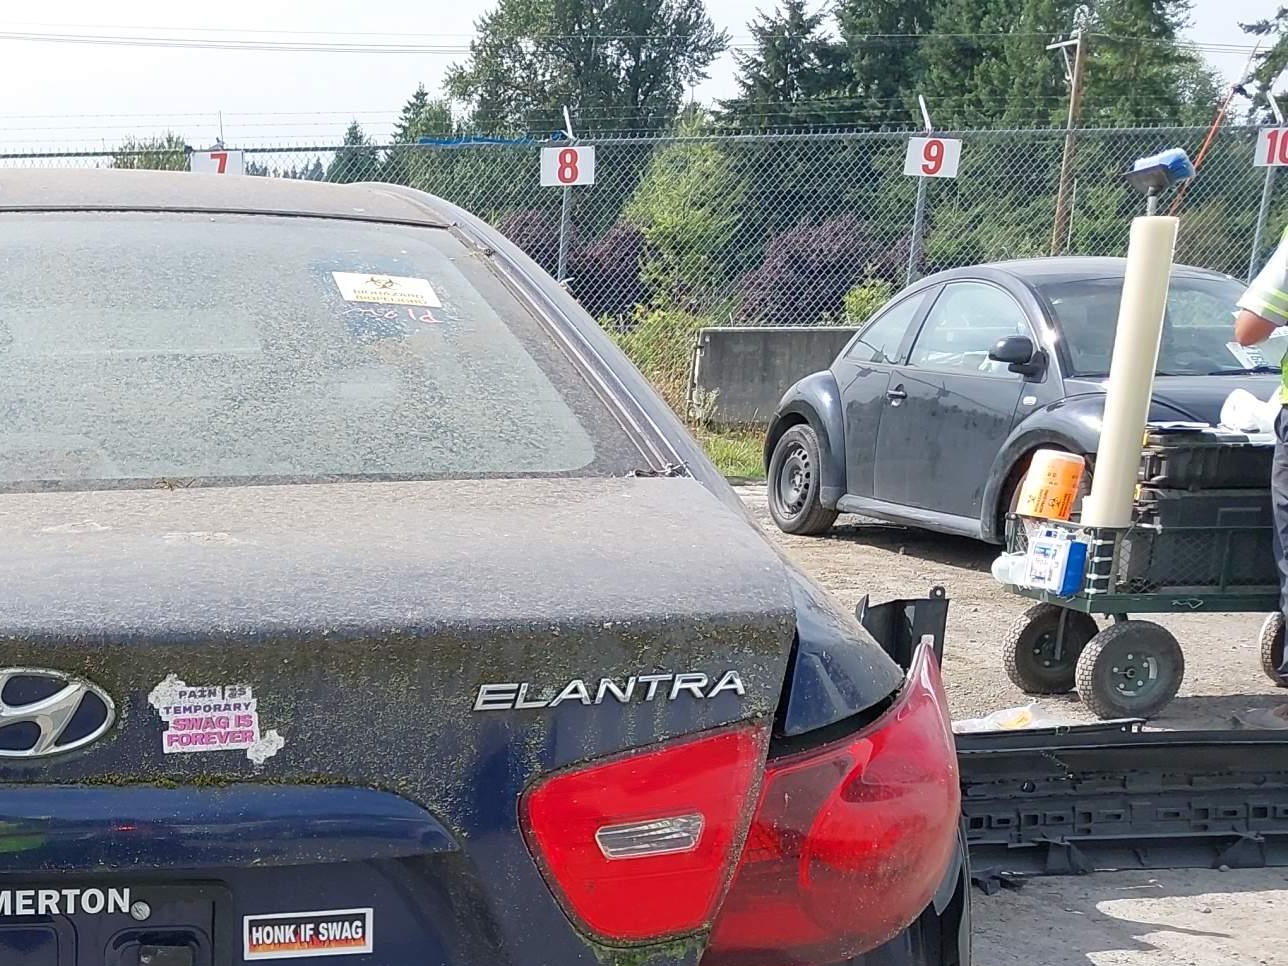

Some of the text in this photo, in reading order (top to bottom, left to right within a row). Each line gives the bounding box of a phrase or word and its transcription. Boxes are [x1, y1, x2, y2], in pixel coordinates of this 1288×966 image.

[209, 151, 228, 174] 7
[557, 148, 579, 185] 8
[921, 139, 945, 176] 9
[178, 687, 217, 700] PAIN
[472, 670, 747, 711] ELANTRA
[163, 702, 252, 715] TEMPORARY
[172, 714, 254, 731] SWAG IS
[167, 730, 255, 747] FOREVER
[251, 920, 363, 945] HONK IF SWAG
